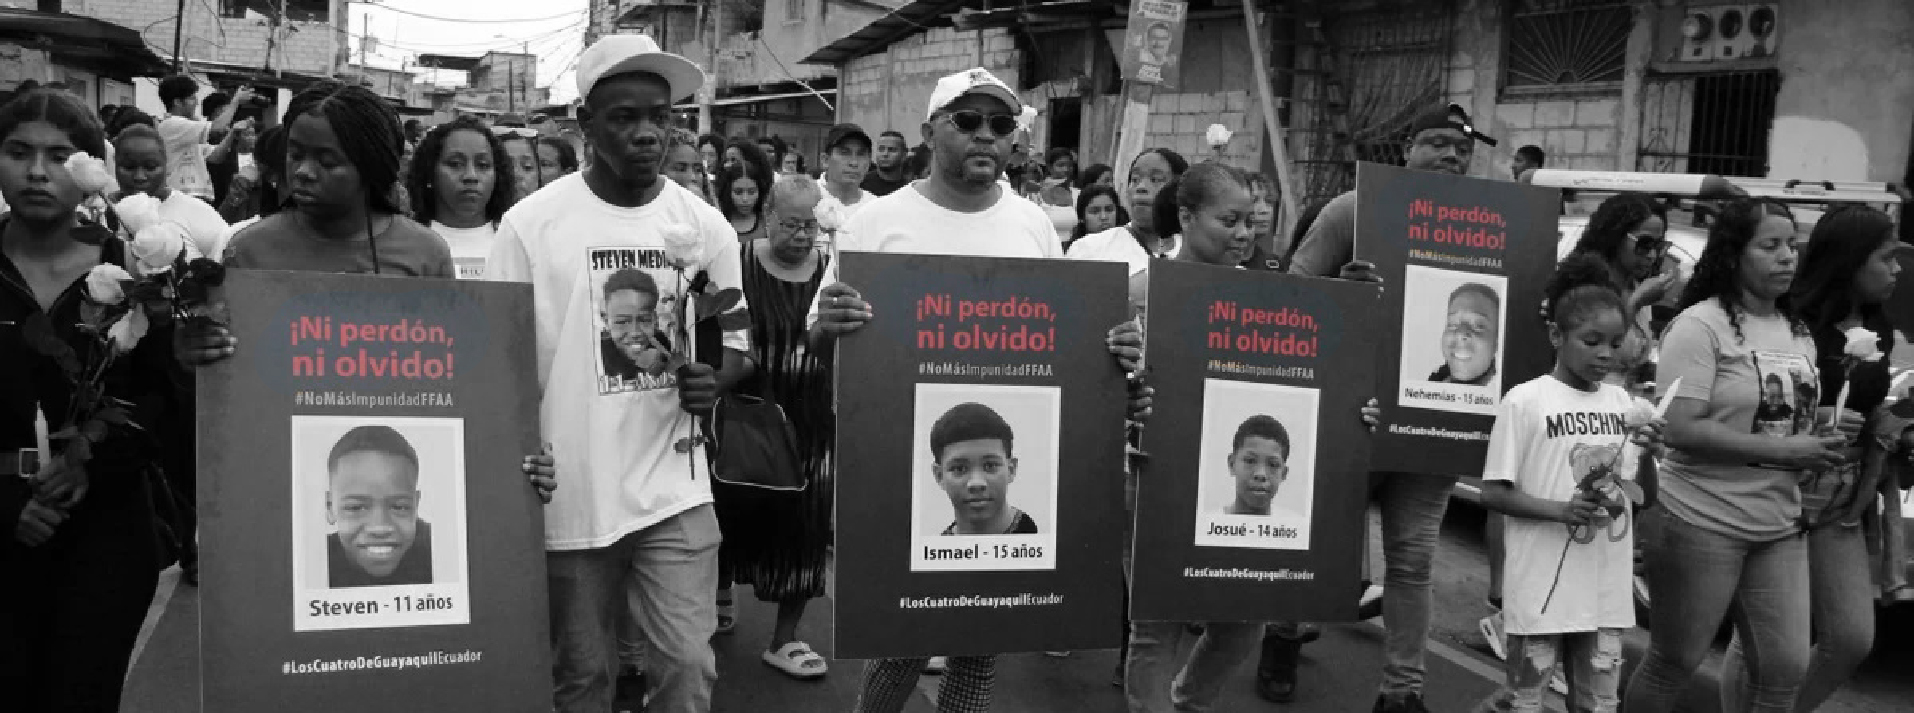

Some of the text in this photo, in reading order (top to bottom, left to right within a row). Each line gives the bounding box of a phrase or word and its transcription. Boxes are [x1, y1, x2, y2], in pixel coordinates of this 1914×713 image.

[1408, 198, 1506, 228] ¡Ni perdón,
[1408, 222, 1506, 250] ni olvido!
[592, 249, 666, 270] STEVEN MEDI
[916, 293, 1057, 323] ¡Ni perdón,
[1207, 300, 1318, 333] ¡Ni perdón,
[290, 316, 454, 349] ¡Ni perdón,
[917, 323, 1056, 351] ni olvido!
[1207, 326, 1318, 358] ni olvido!
[292, 348, 454, 380] ni olvido!
[918, 361, 1054, 379] #NoMásImpunidadFFAA
[294, 391, 454, 409] #NoMásImpunidadFFAA
[1546, 412, 1625, 439] MOSCHIN
[1207, 522, 1247, 537] Josué
[1258, 524, 1271, 537] 14
[1272, 525, 1298, 539] años
[924, 543, 979, 560] Ismael
[993, 545, 1008, 559] 15
[1011, 543, 1043, 559] años
[309, 599, 379, 617] Steven
[393, 595, 411, 612] 11
[416, 593, 453, 612] años
[900, 592, 1065, 609] #LosCuatroDeGuayaquilEcuador
[281, 649, 483, 676] #LosCuatroDeGuayaquilEcuador
